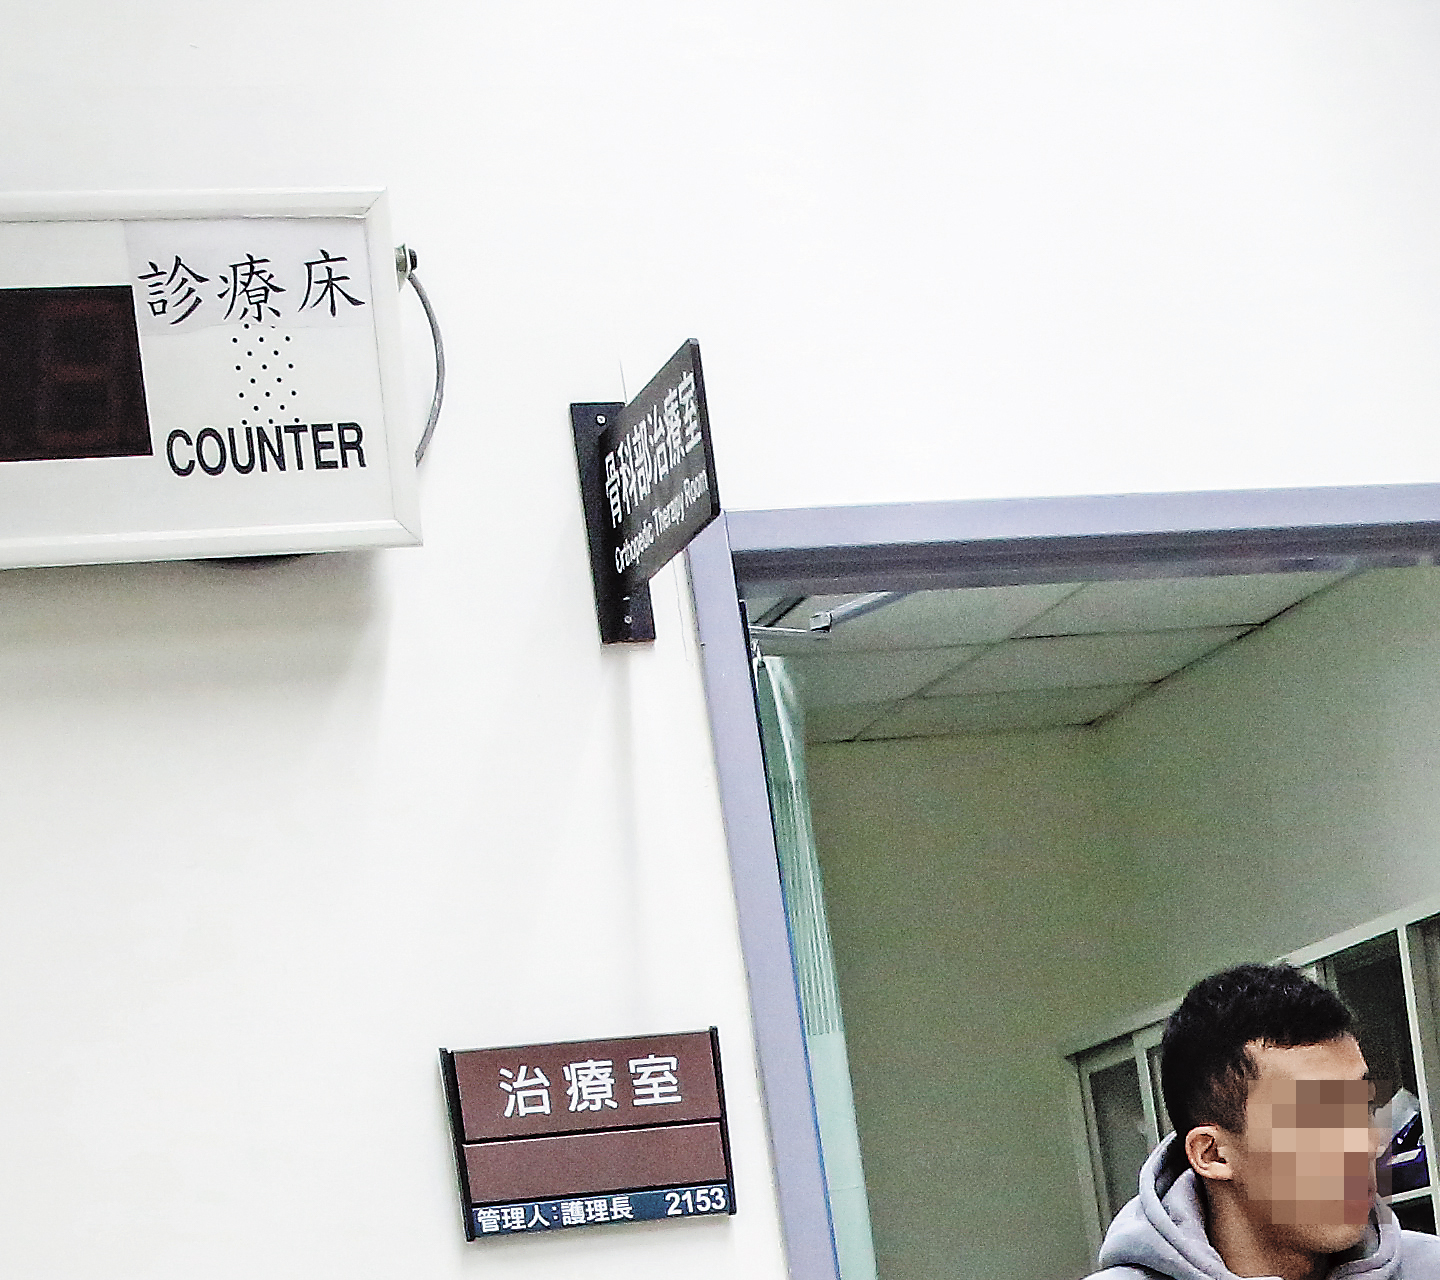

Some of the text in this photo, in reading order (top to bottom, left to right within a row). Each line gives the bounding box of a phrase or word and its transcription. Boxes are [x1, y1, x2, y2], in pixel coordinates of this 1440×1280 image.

[138, 248, 365, 326] 診療床
[165, 421, 368, 476] COUNTER
[652, 492, 686, 537] Therapy
[683, 469, 709, 508] Room
[498, 1053, 683, 1118] 治療室
[665, 1187, 727, 1217] 2153
